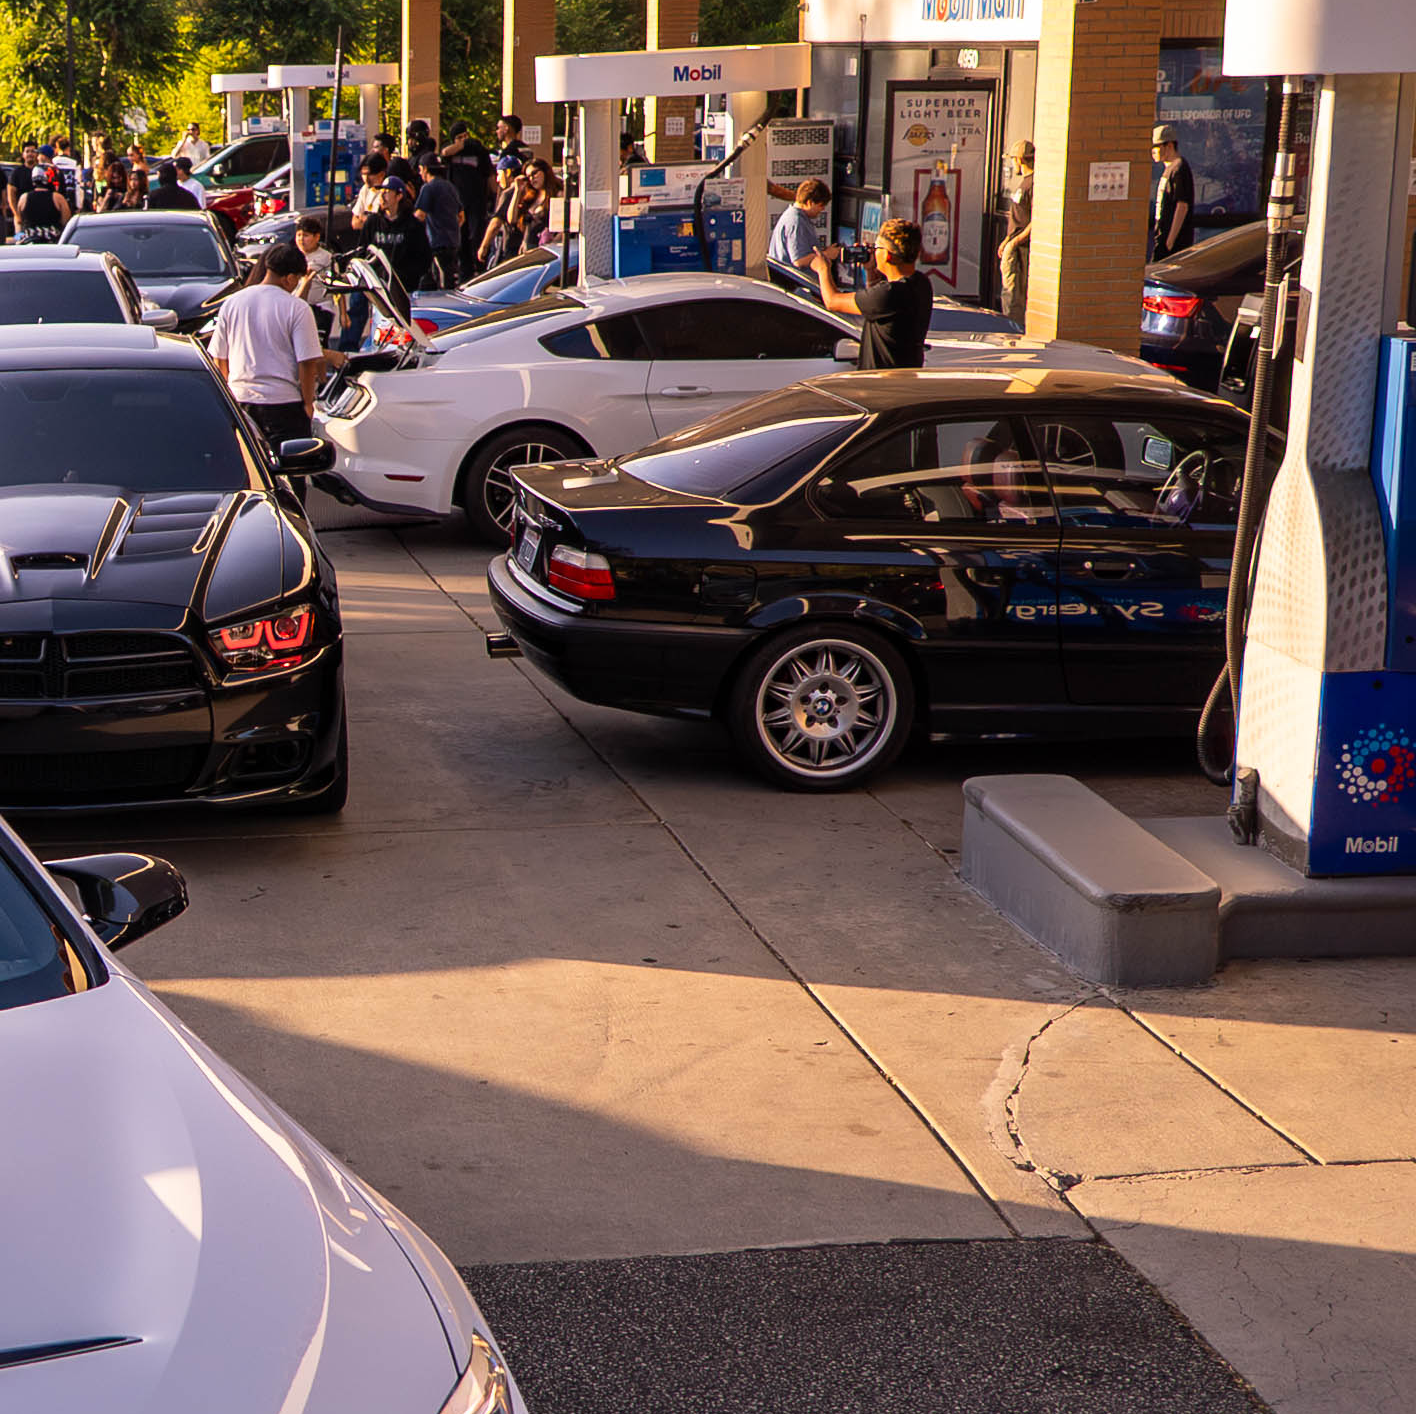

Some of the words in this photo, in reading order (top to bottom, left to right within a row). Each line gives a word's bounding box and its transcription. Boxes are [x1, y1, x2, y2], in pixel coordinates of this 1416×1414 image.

[673, 63, 722, 82] Mobil
[906, 98, 975, 108] SUPERIOR
[900, 110, 940, 119] LIGHT
[947, 109, 981, 118] BEER
[731, 211, 743, 223] 12
[1345, 836, 1399, 853] Mobil
